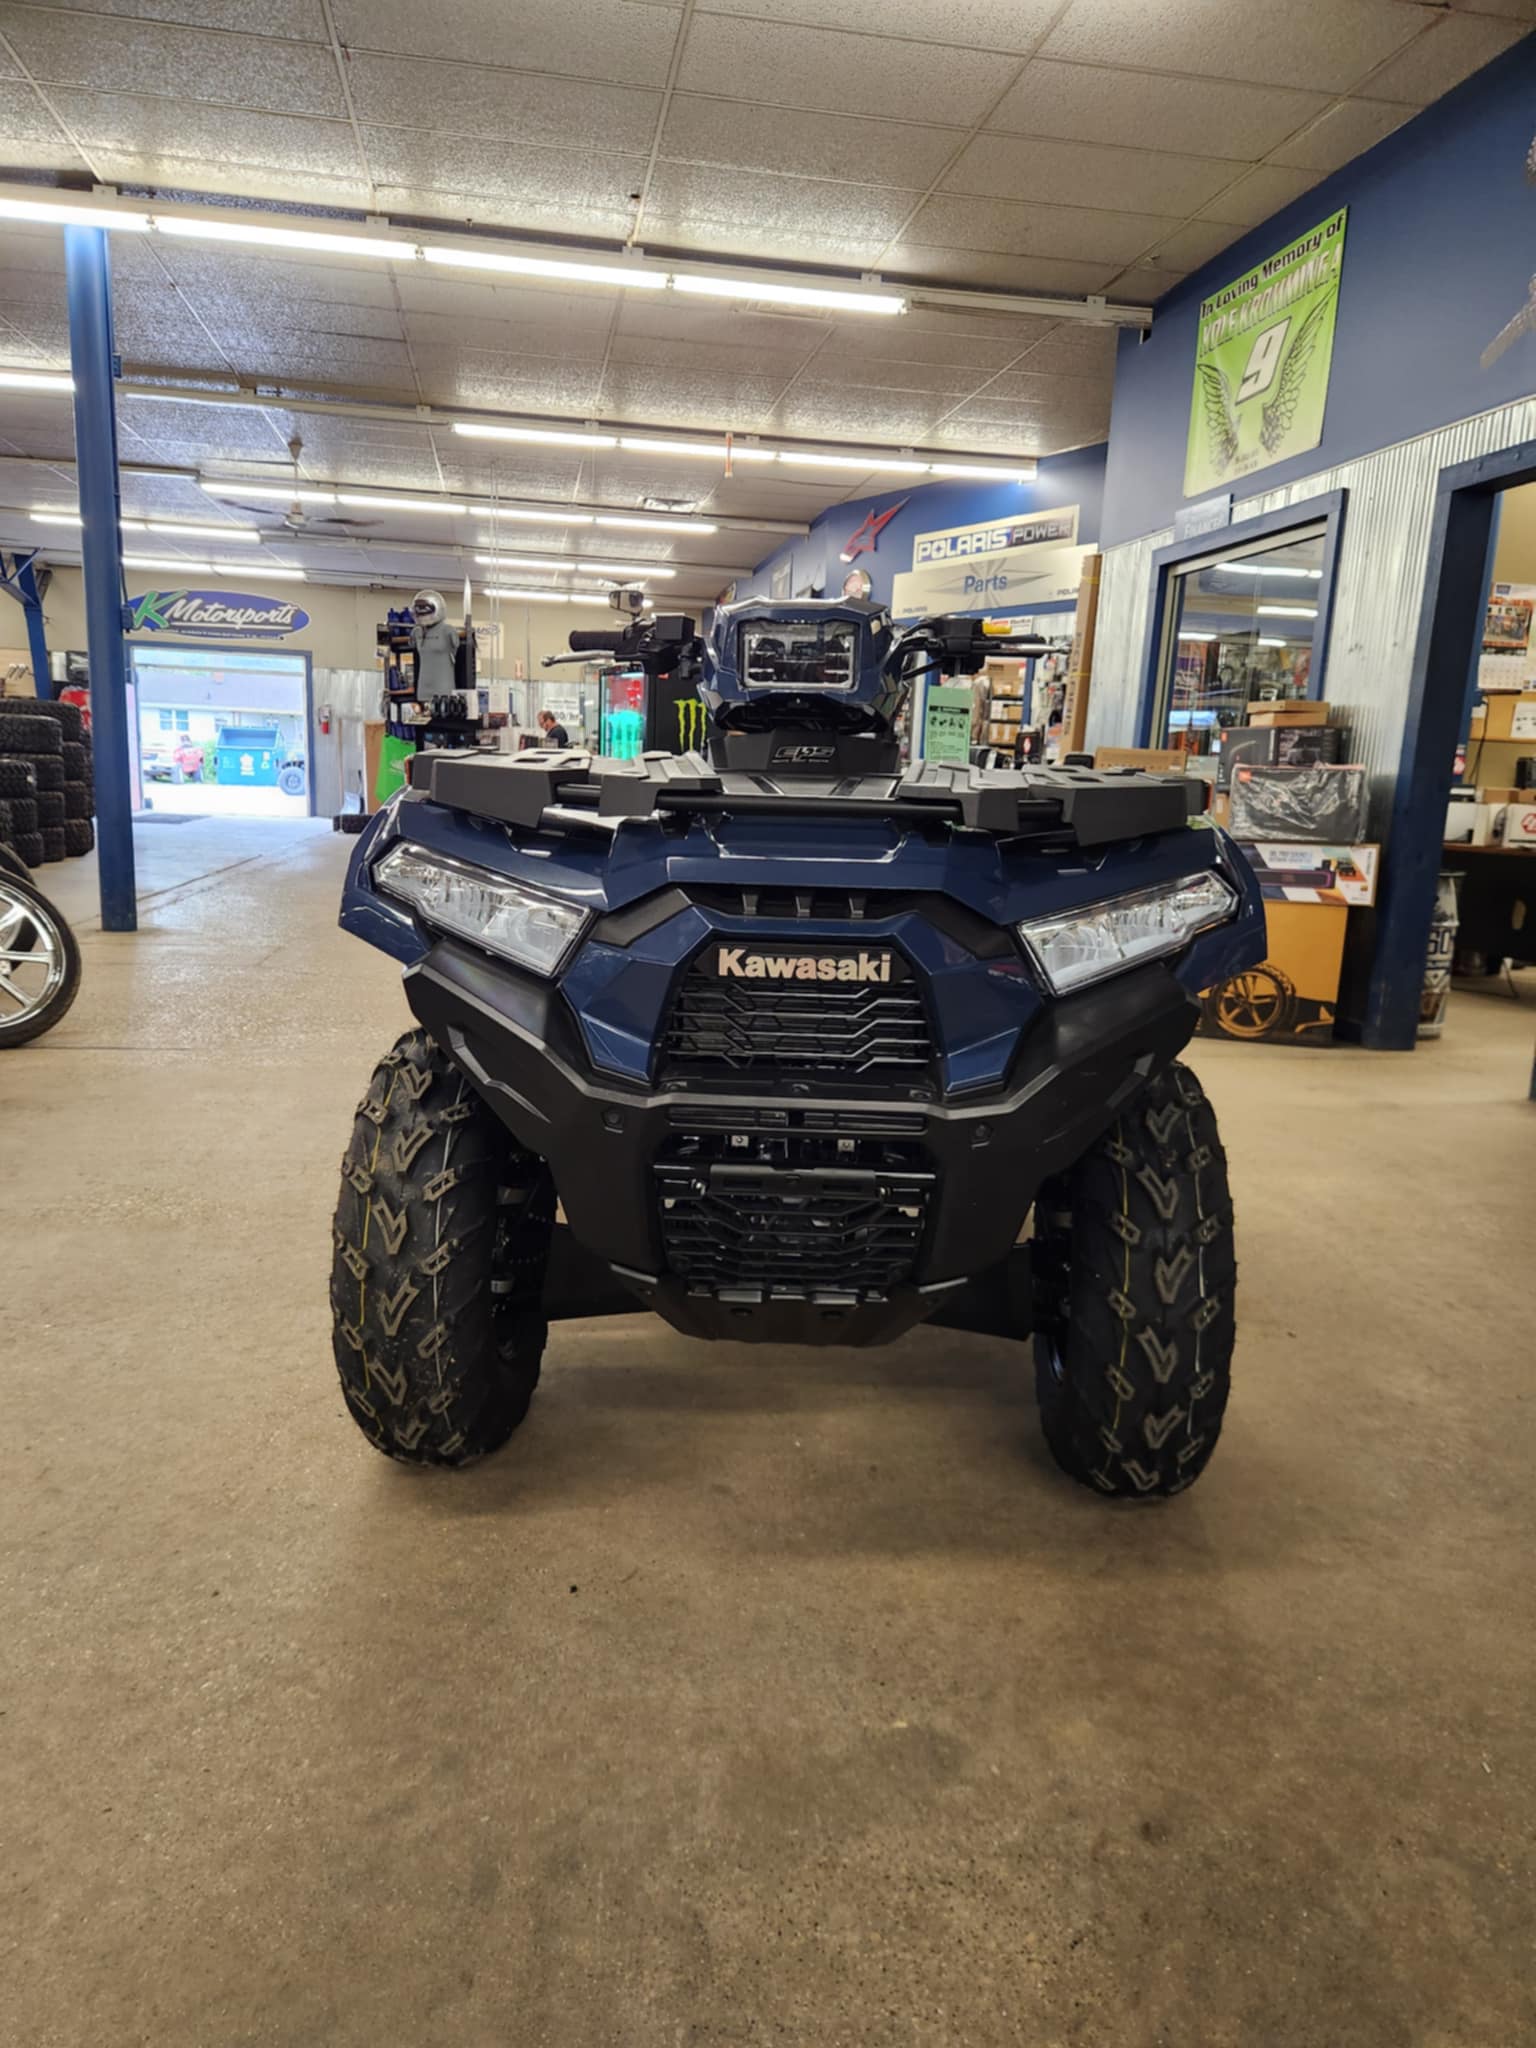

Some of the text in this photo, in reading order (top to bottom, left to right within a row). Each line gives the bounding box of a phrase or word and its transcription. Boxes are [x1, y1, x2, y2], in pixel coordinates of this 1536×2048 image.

[1201, 213, 1344, 319] In Loving Memory of
[1235, 318, 1290, 406] 9
[917, 521, 1072, 562] POLARIS POWER
[964, 574, 1007, 594] Parts
[164, 599, 297, 630] Motorsports
[718, 948, 891, 982] Kawasaki
